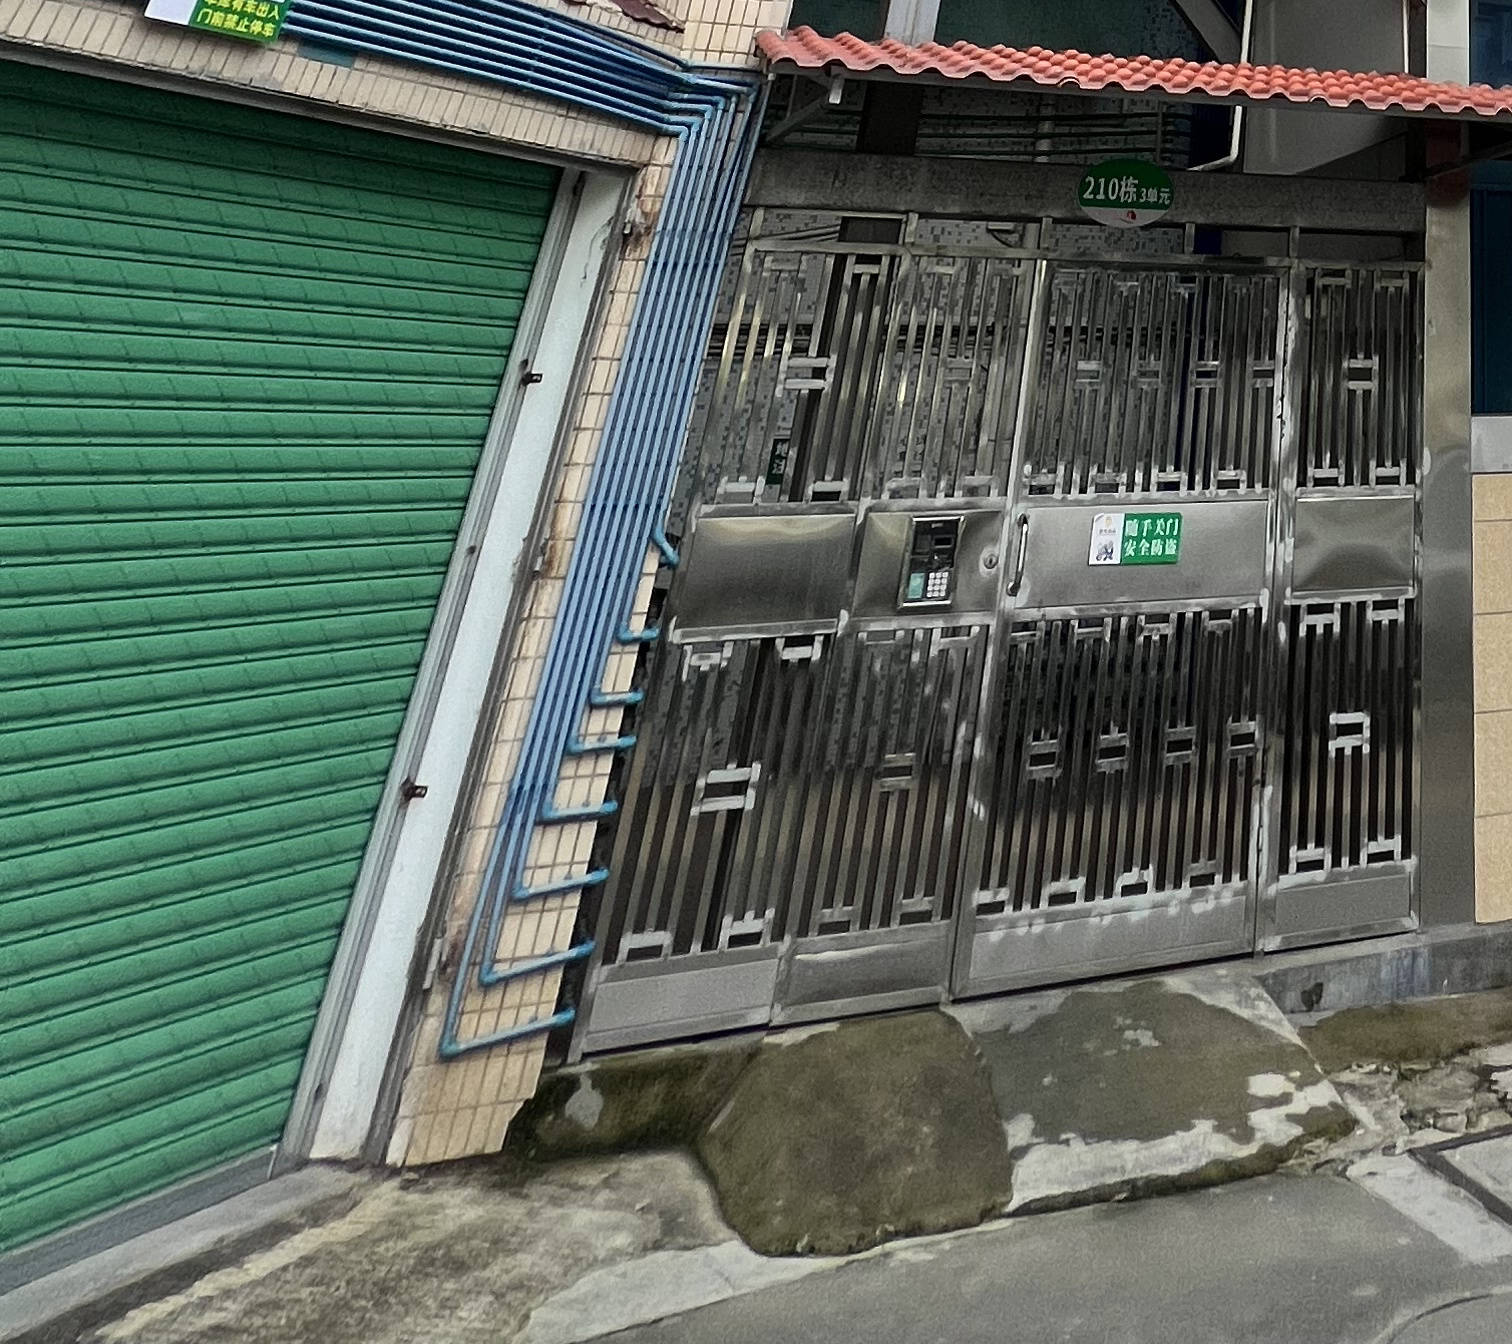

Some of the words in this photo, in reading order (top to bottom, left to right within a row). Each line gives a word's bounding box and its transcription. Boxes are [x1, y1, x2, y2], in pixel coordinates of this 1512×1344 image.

[196, 8, 276, 38] 门前禁止停车
[1125, 518, 1179, 537] 随手关门
[1124, 538, 1178, 557] 安全防盗
